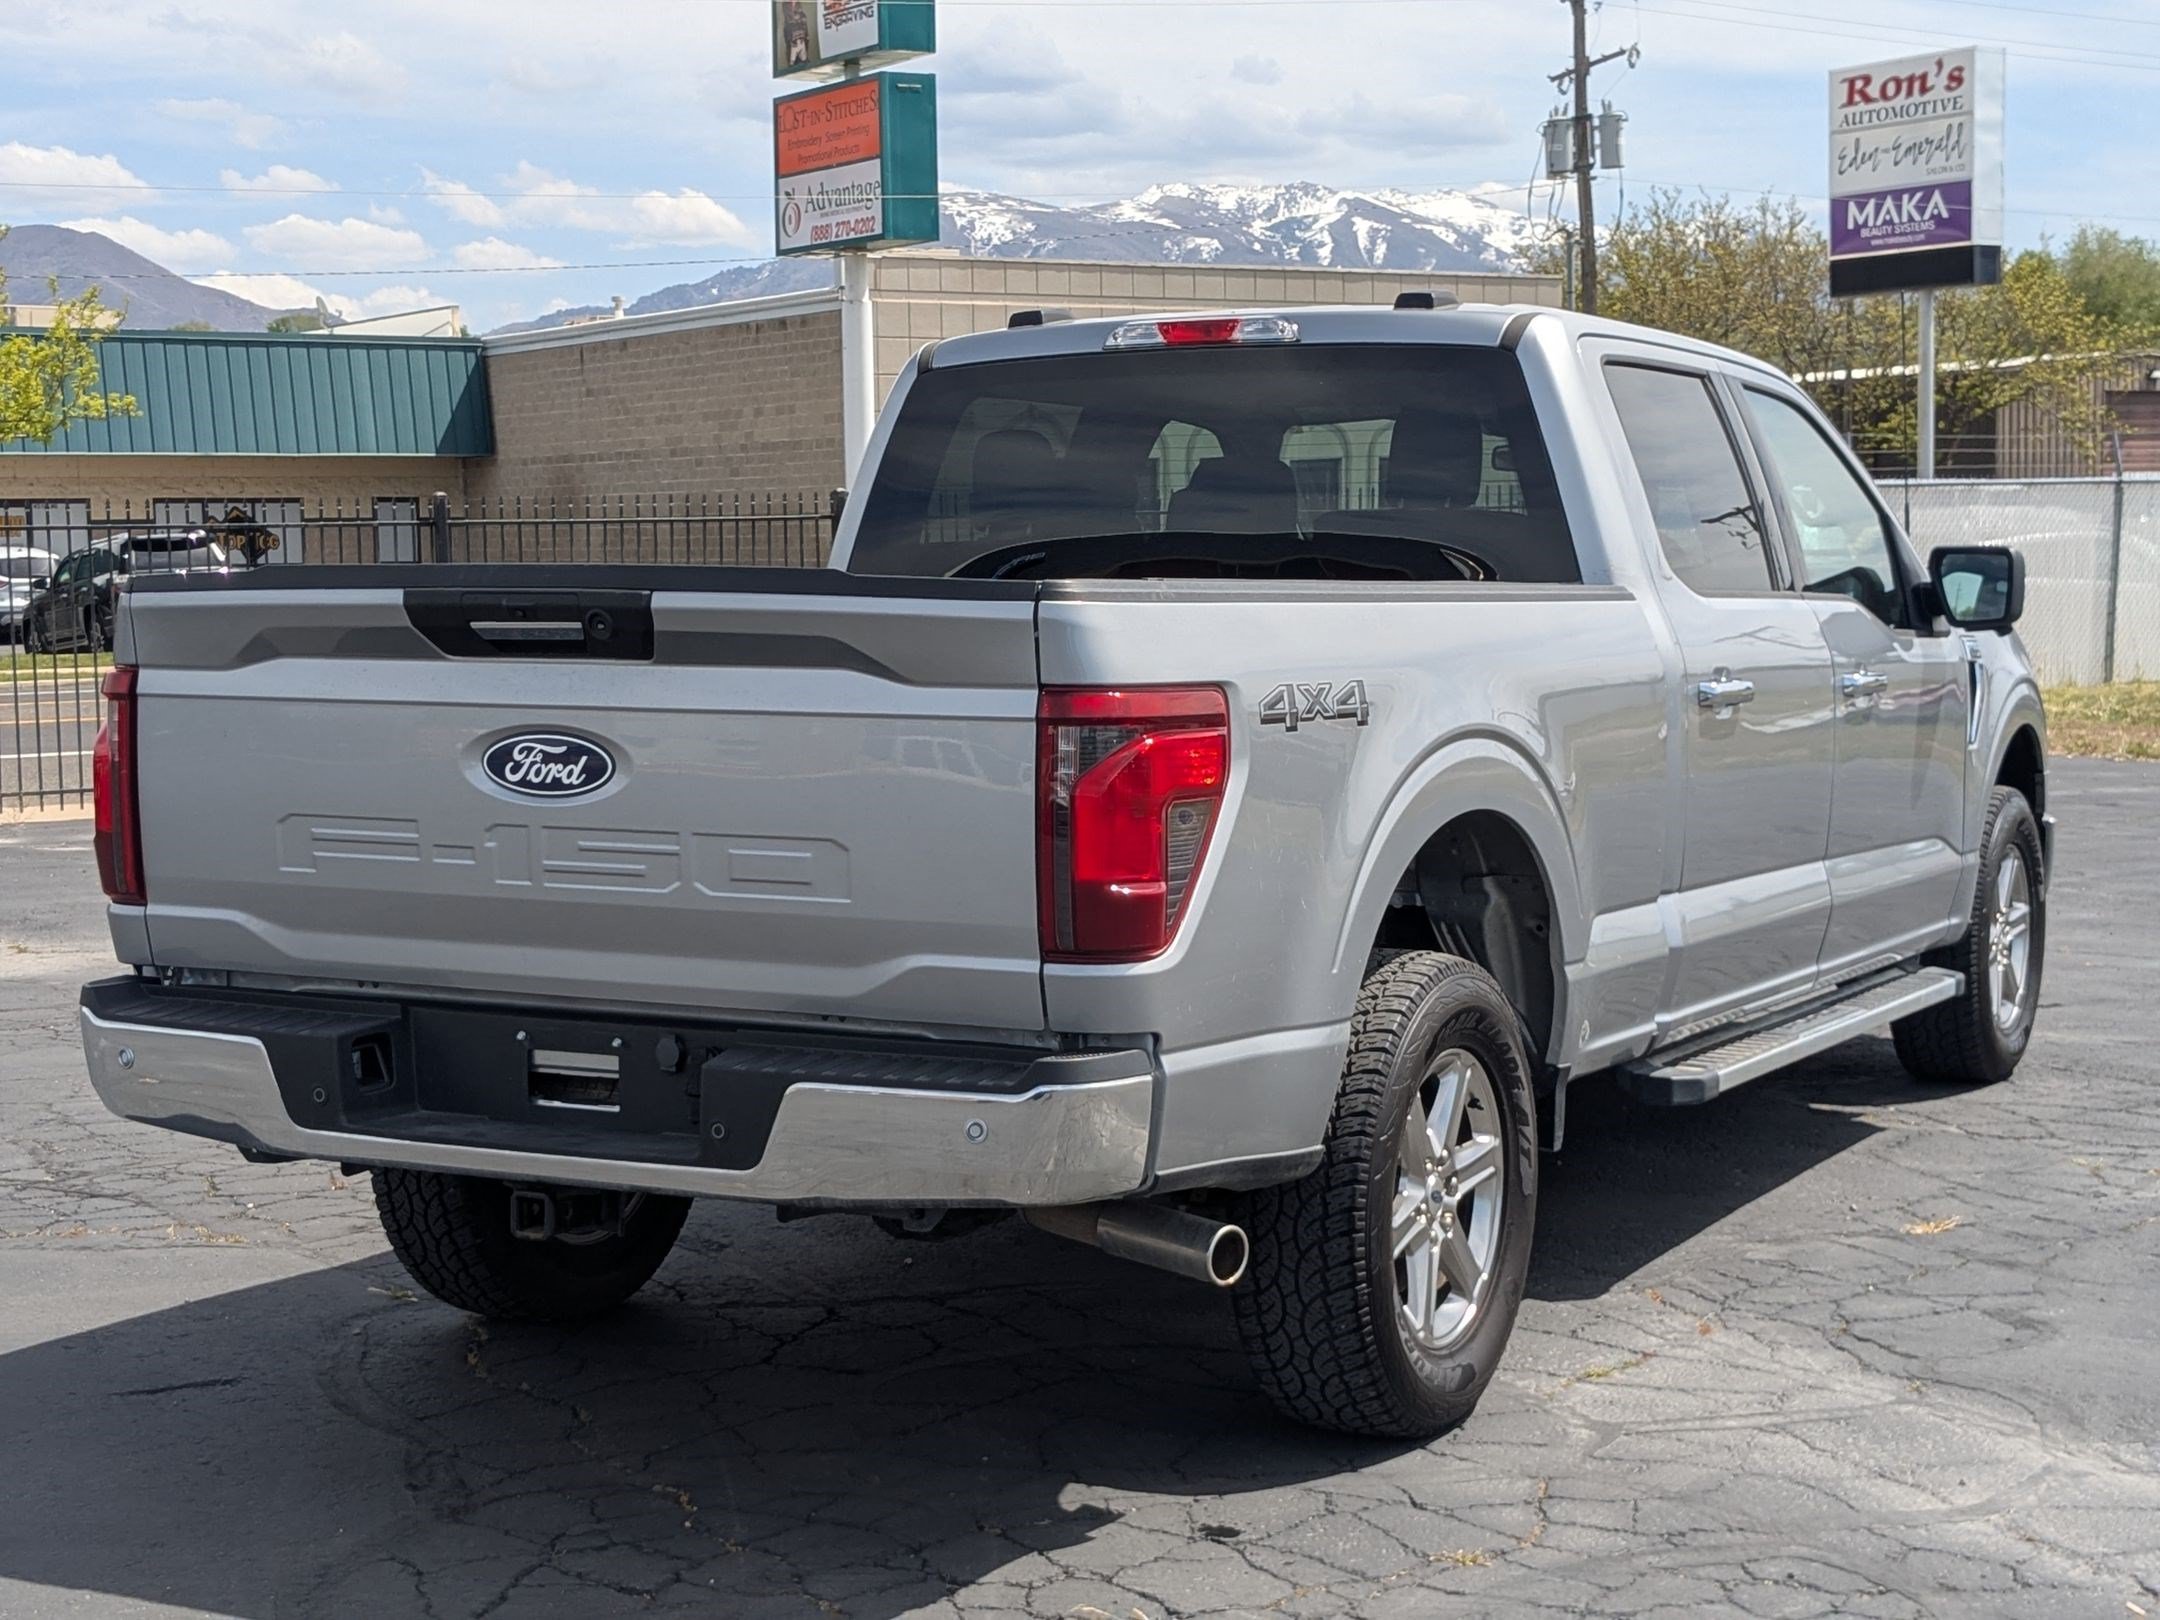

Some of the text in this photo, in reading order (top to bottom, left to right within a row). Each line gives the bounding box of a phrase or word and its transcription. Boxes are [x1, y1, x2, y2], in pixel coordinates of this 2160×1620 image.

[1838, 58, 1965, 109] Ron's
[1840, 95, 1964, 128] AUTOMOTIVE
[804, 180, 880, 213] Advantage
[1847, 189, 1949, 230] MAKA
[1860, 220, 1935, 238] BEAUTY SYSTEMS
[504, 742, 588, 785] Ford
[276, 813, 851, 903] F-150
